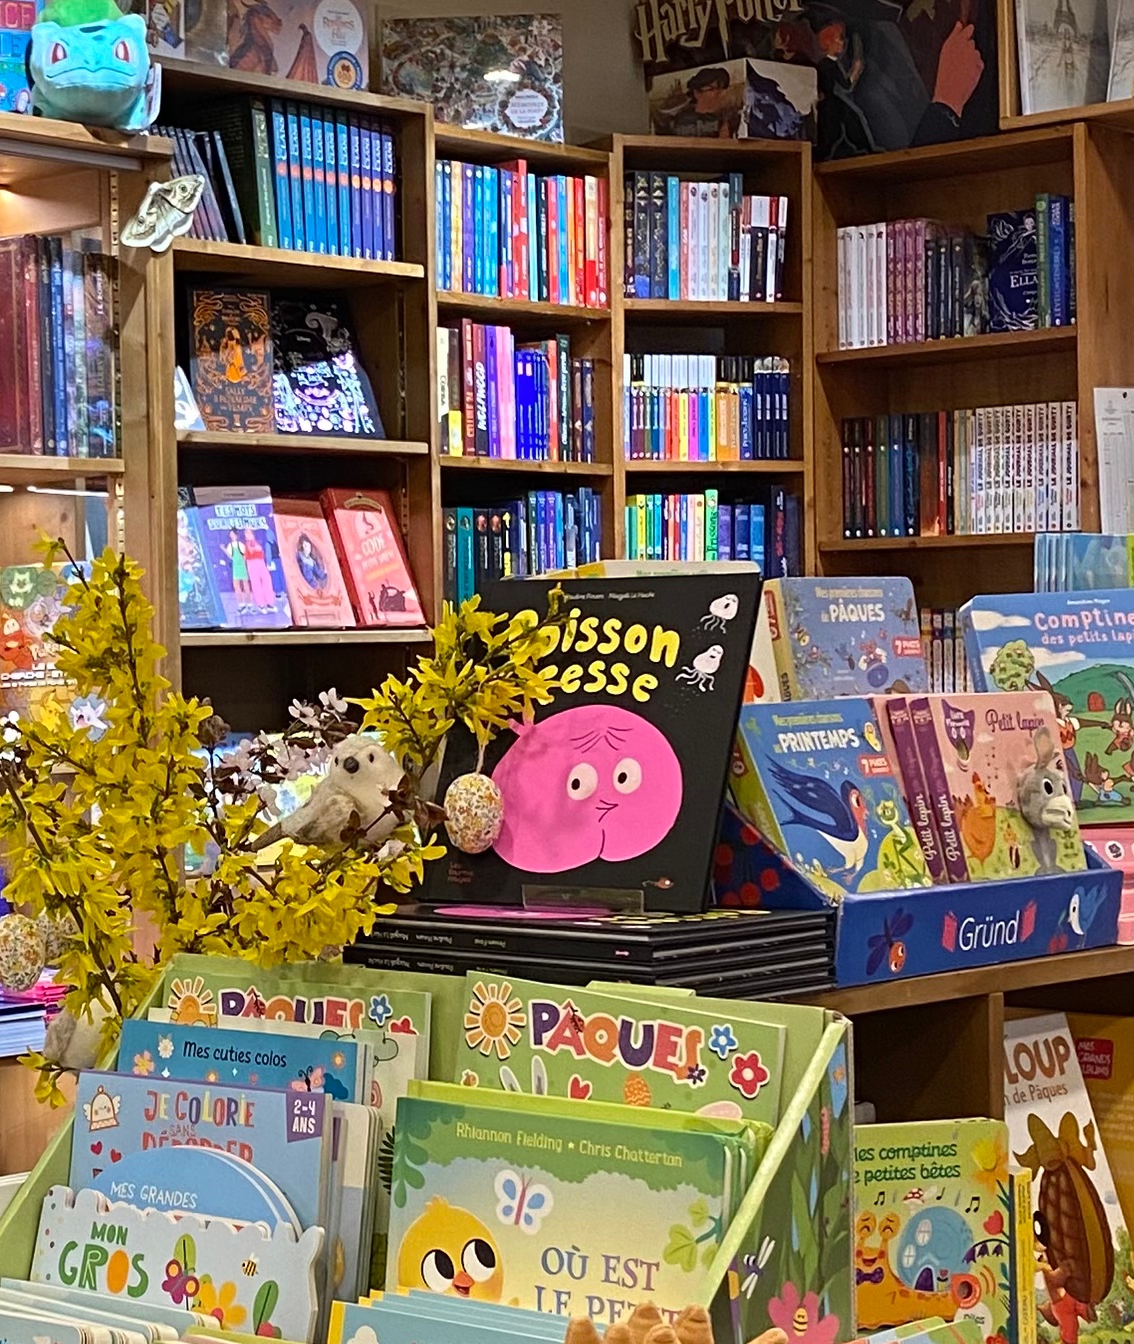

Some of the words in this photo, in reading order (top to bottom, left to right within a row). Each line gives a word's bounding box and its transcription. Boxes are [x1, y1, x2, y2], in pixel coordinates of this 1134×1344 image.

[830, 599, 885, 622] PÂQUES
[1042, 634, 1064, 644] des
[1069, 630, 1108, 646] petits
[778, 728, 860, 753] PRINTEMPS
[958, 909, 1021, 952] Gründ
[530, 999, 705, 1080] PÂQUES
[183, 1040, 210, 1059] Mes
[212, 1045, 252, 1065] cuties
[254, 1050, 287, 1068] colos
[1003, 1034, 1071, 1086] LOUP
[1013, 1087, 1027, 1103] de
[1030, 1082, 1069, 1102] Pâques
[143, 1090, 170, 1121] JE
[174, 1090, 256, 1128] COLORIE
[293, 1099, 317, 1116] 2-4
[292, 1117, 316, 1134] ANS
[456, 1121, 514, 1146] Rhiannon
[516, 1128, 563, 1152] Fielding
[579, 1137, 612, 1160] Chris
[614, 1141, 683, 1168] Chatterton
[878, 1142, 958, 1162] comptines
[864, 1166, 916, 1186] petites
[920, 1162, 961, 1180] bêtes
[109, 1181, 137, 1199] MES
[140, 1185, 198, 1208] GRANDES
[90, 1221, 128, 1244] MON
[58, 1240, 149, 1298] GROS
[541, 1245, 590, 1280] OÙ
[601, 1256, 660, 1292] EST
[535, 1285, 571, 1314] LE
